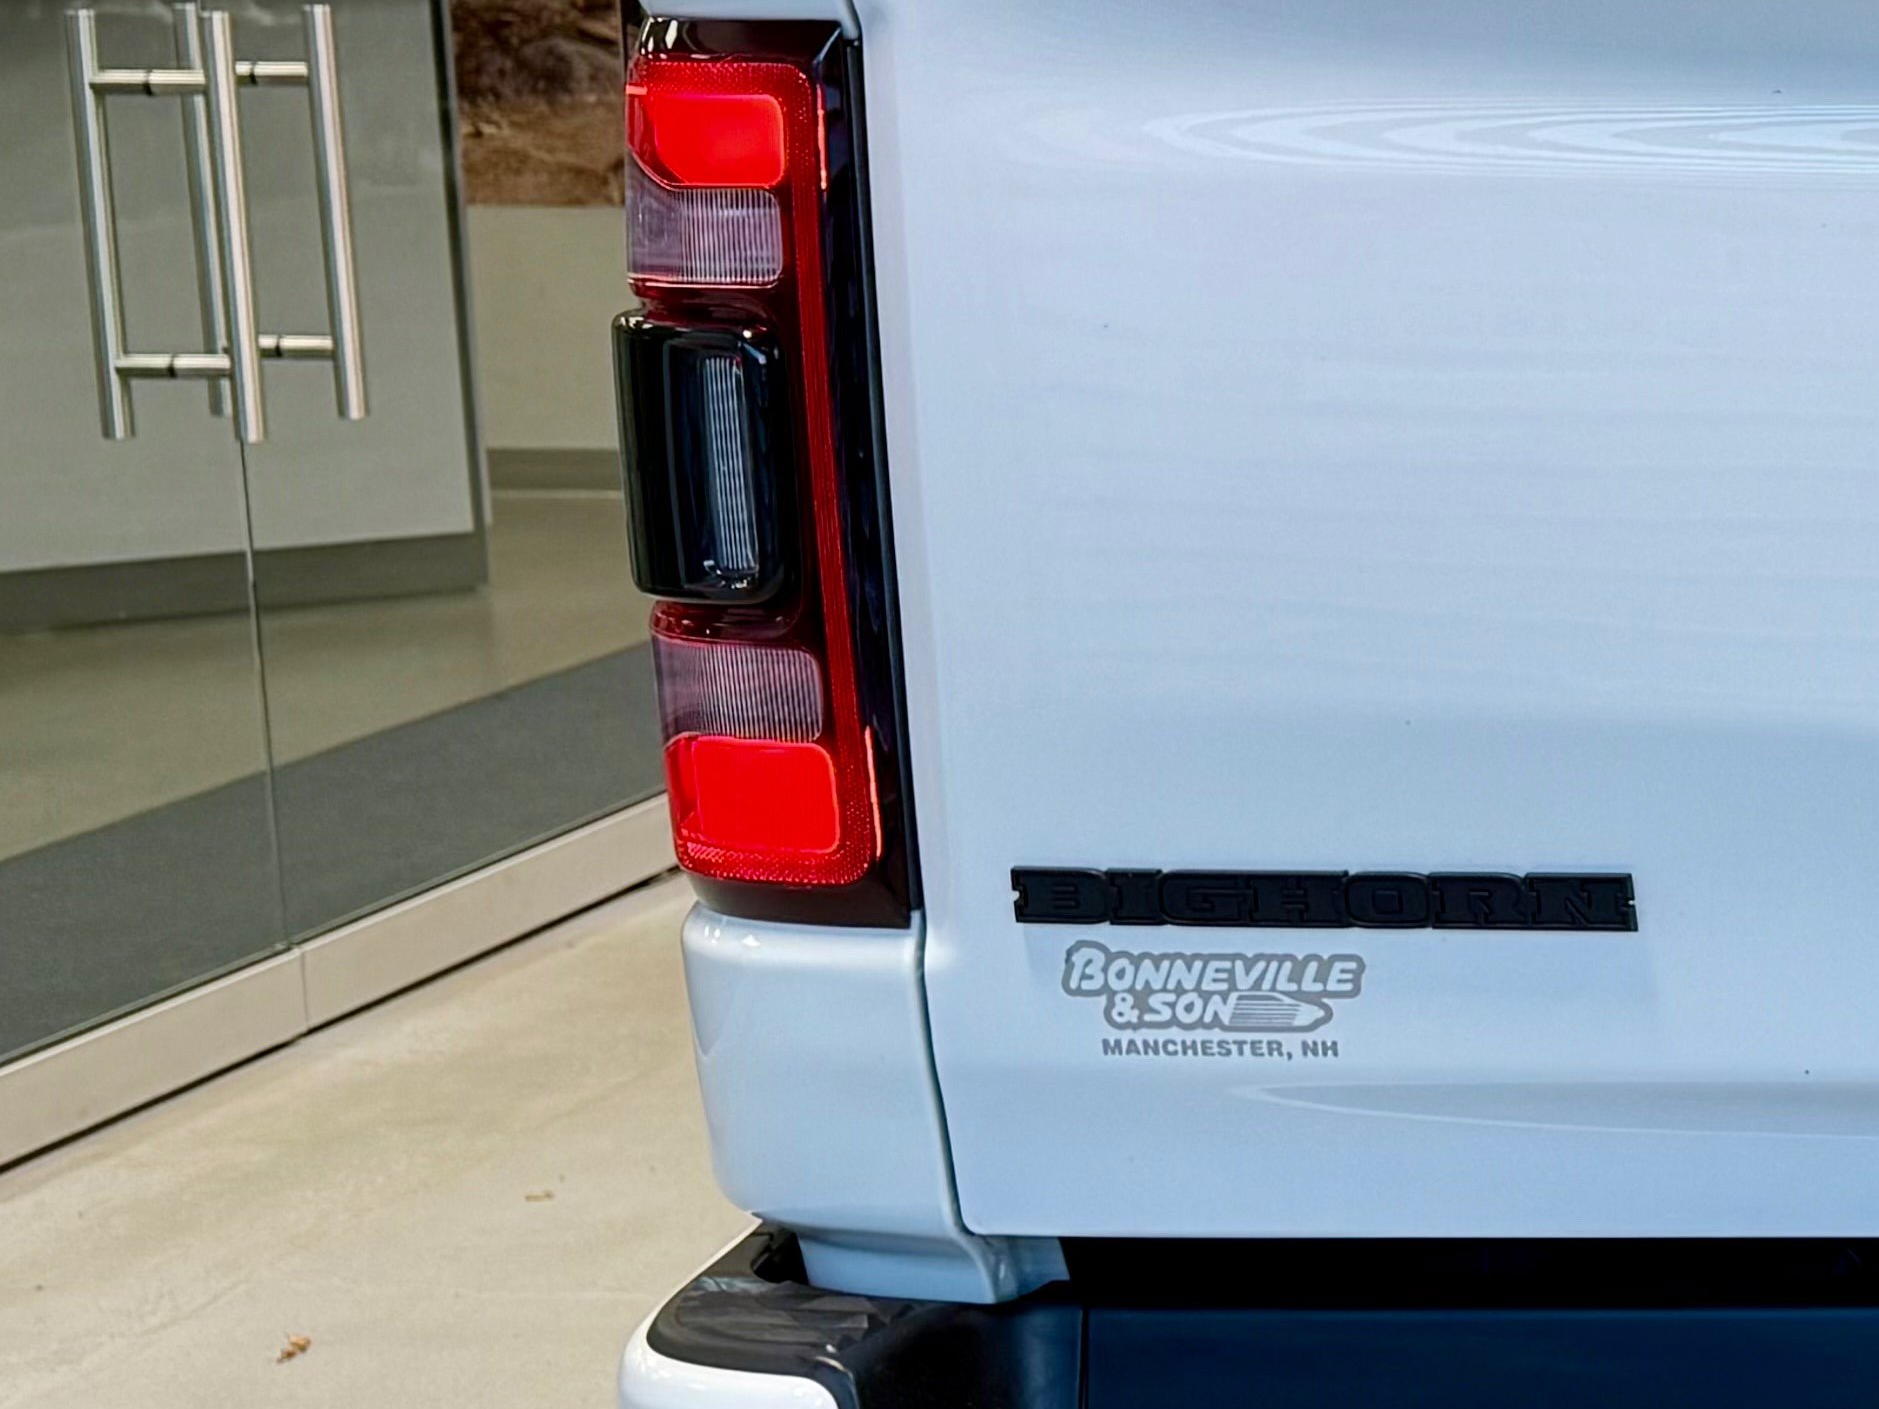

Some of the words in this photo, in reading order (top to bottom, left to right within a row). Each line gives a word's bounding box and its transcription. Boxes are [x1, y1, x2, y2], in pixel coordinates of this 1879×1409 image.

[1068, 947, 1358, 992] BONNEVILLE
[1101, 1039, 1294, 1061] MANCHESTER,
[1301, 1040, 1339, 1058] NH
